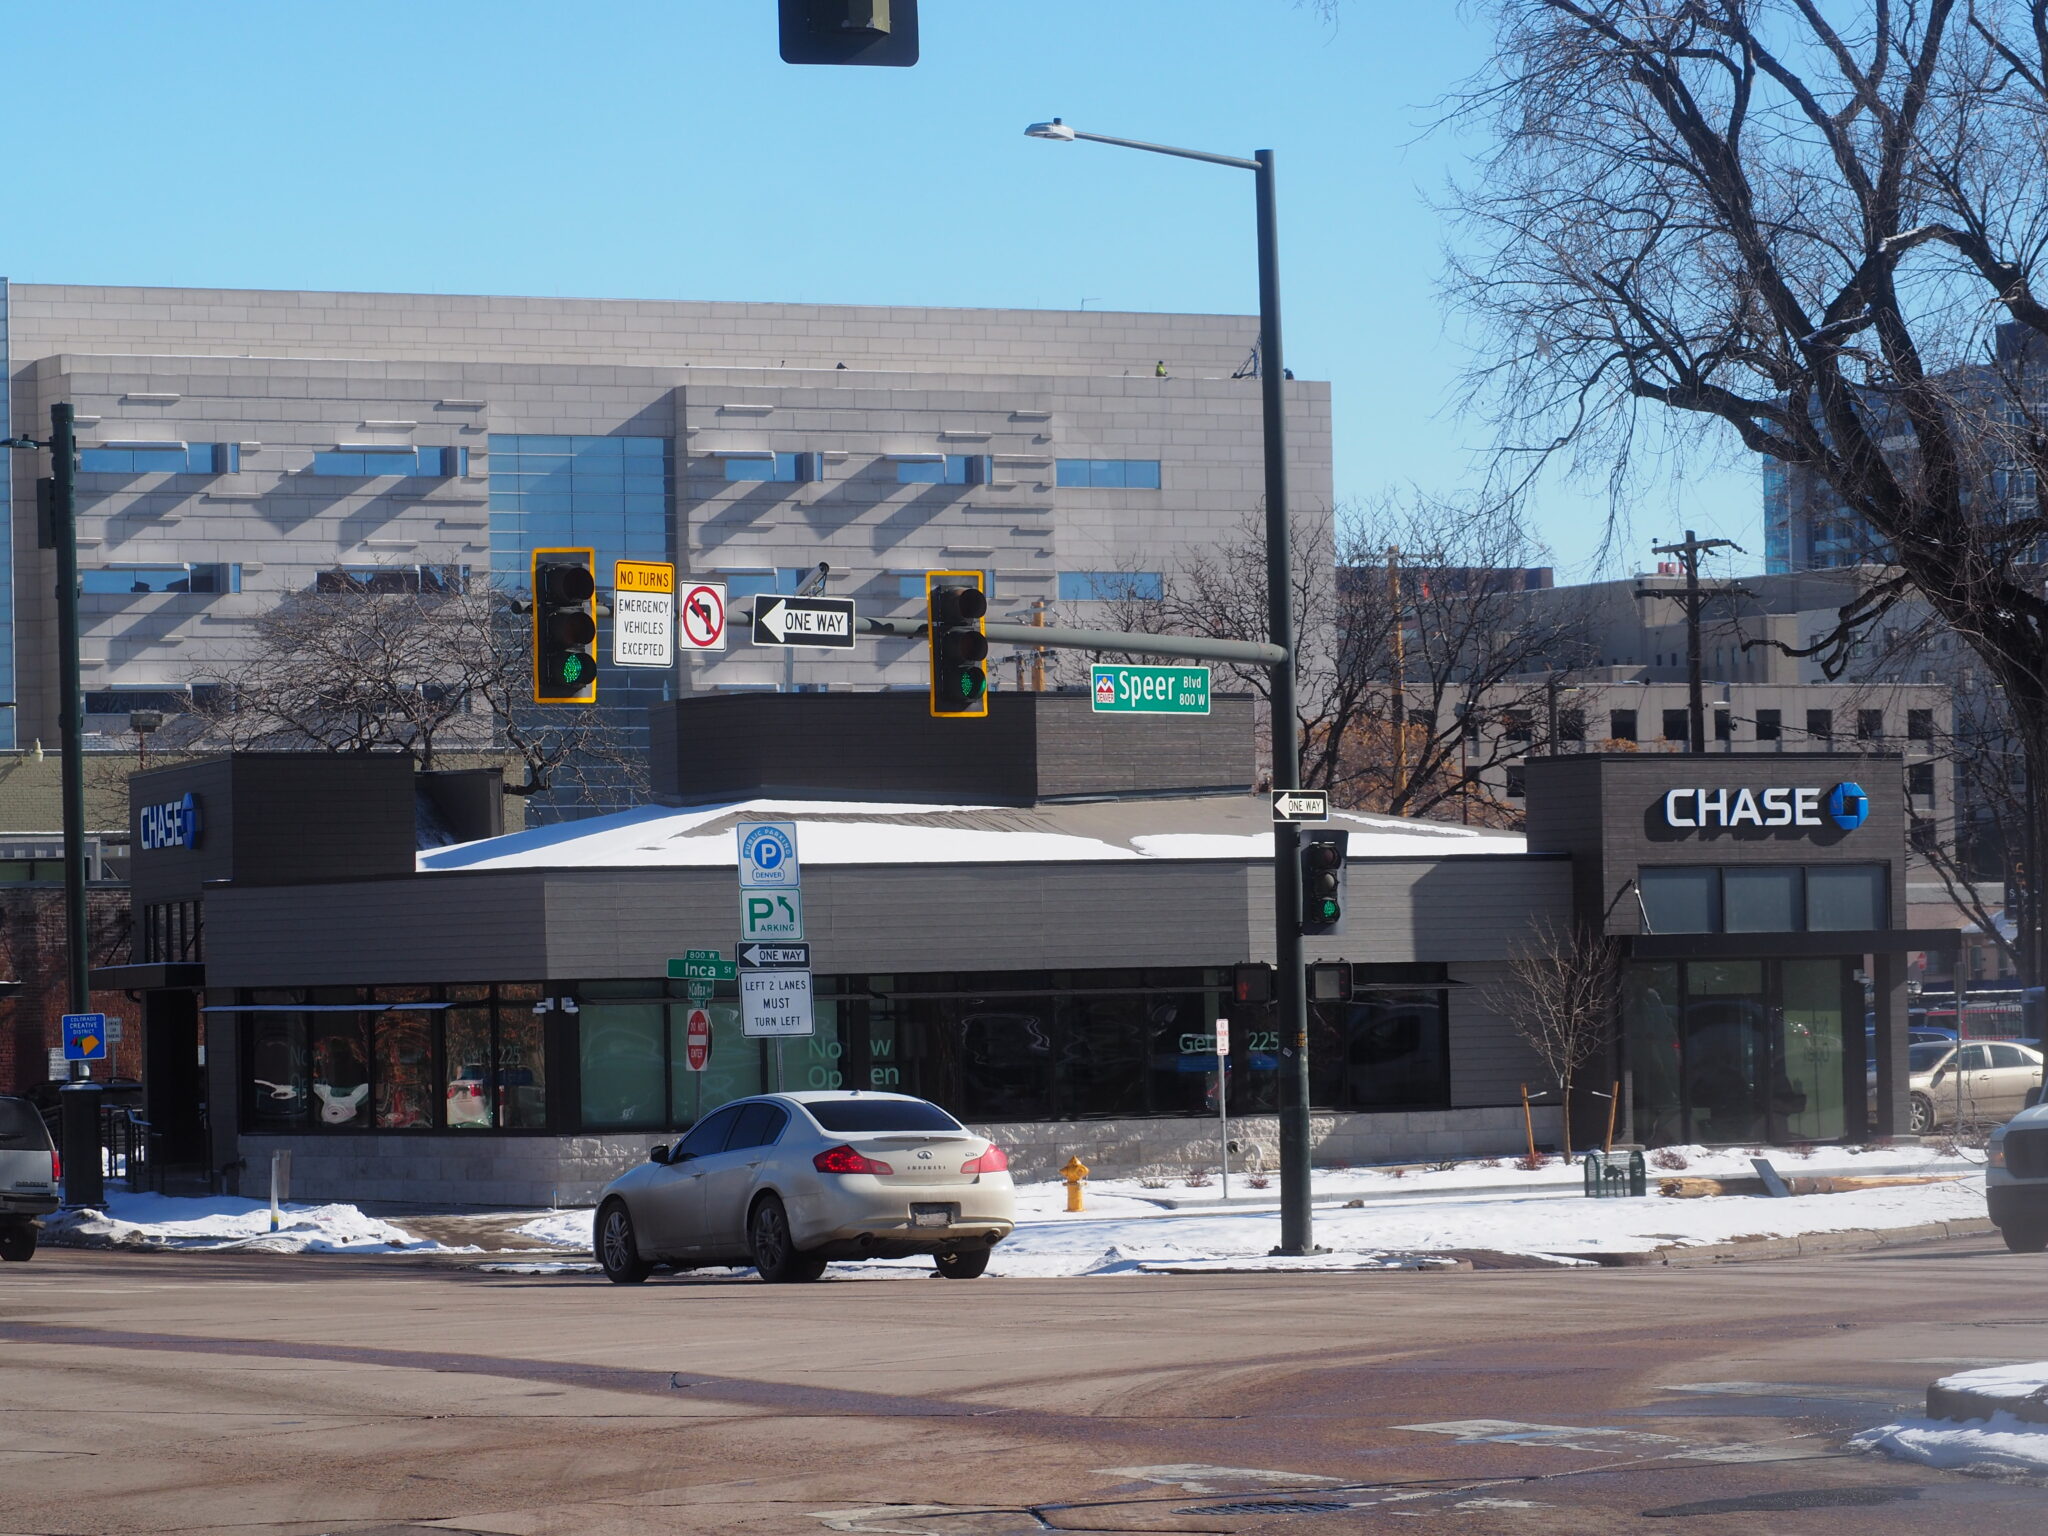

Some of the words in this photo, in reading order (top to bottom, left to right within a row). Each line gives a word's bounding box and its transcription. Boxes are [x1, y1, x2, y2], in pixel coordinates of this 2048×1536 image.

[620, 571, 633, 585] NO
[639, 572, 669, 587] TURNS
[619, 599, 669, 614] EMERGENCY
[624, 621, 664, 635] VEHICLES
[785, 612, 811, 631] ONE
[816, 614, 844, 632] WAY
[622, 642, 664, 656] EXCEPTED
[1119, 671, 1175, 707] Speer
[1183, 676, 1202, 688] Blvd
[1179, 694, 1196, 705] 800
[1198, 694, 1206, 705] W
[1288, 800, 1303, 812] ONE
[1306, 800, 1321, 812] WAY
[1665, 788, 1822, 827] CHASE
[141, 801, 184, 849] CHASE
[745, 830, 762, 855] PUBLIC
[764, 829, 792, 855] PARKING
[761, 843, 777, 865] P
[689, 951, 705, 959] 800
[760, 950, 779, 960] ONE
[782, 950, 802, 960] WAY
[685, 962, 716, 977] Inca
[724, 966, 731, 974] St
[745, 981, 765, 991] LEFT
[769, 981, 775, 991] 2
[779, 980, 806, 990] LANES
[763, 998, 790, 1009] MUST
[755, 1017, 777, 1026] TURN
[781, 1016, 801, 1026] LEFT
